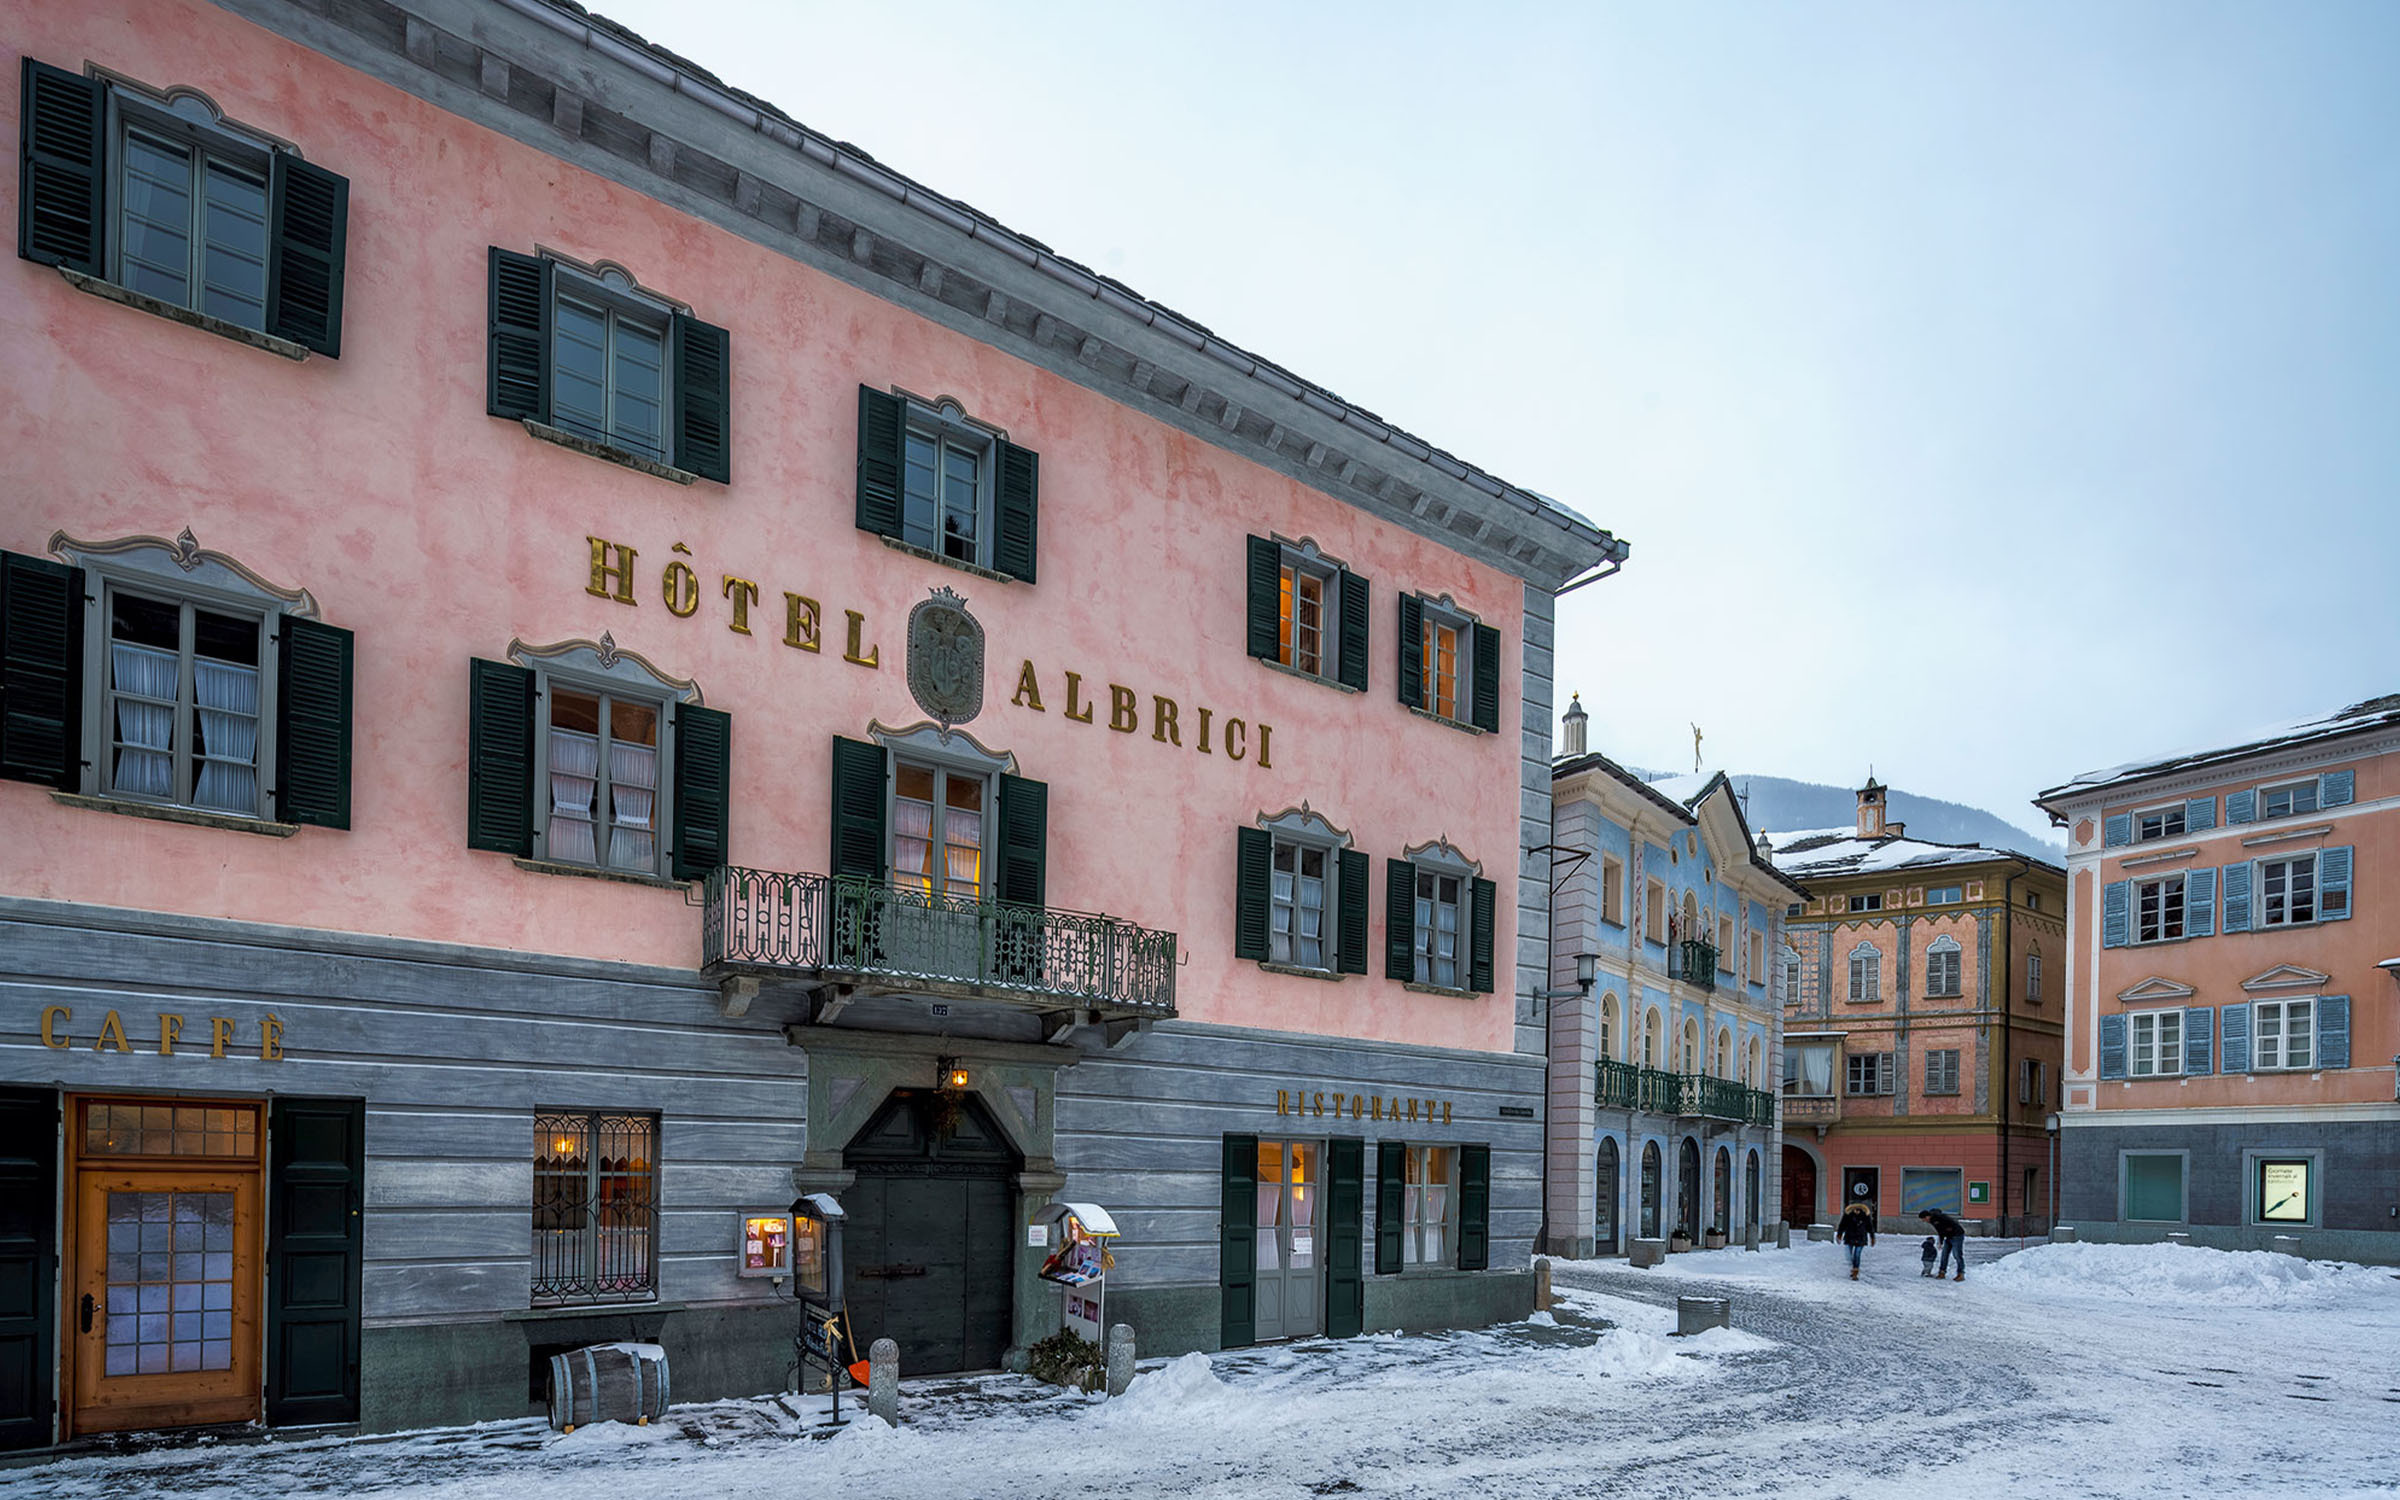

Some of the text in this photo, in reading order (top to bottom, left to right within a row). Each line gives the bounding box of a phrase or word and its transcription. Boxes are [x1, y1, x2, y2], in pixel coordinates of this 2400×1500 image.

[585, 536, 1273, 769] HÔTEL ALBRICI
[41, 1005, 285, 1061] CAFFÈ
[1277, 1089, 1453, 1125] RISTORANTE
